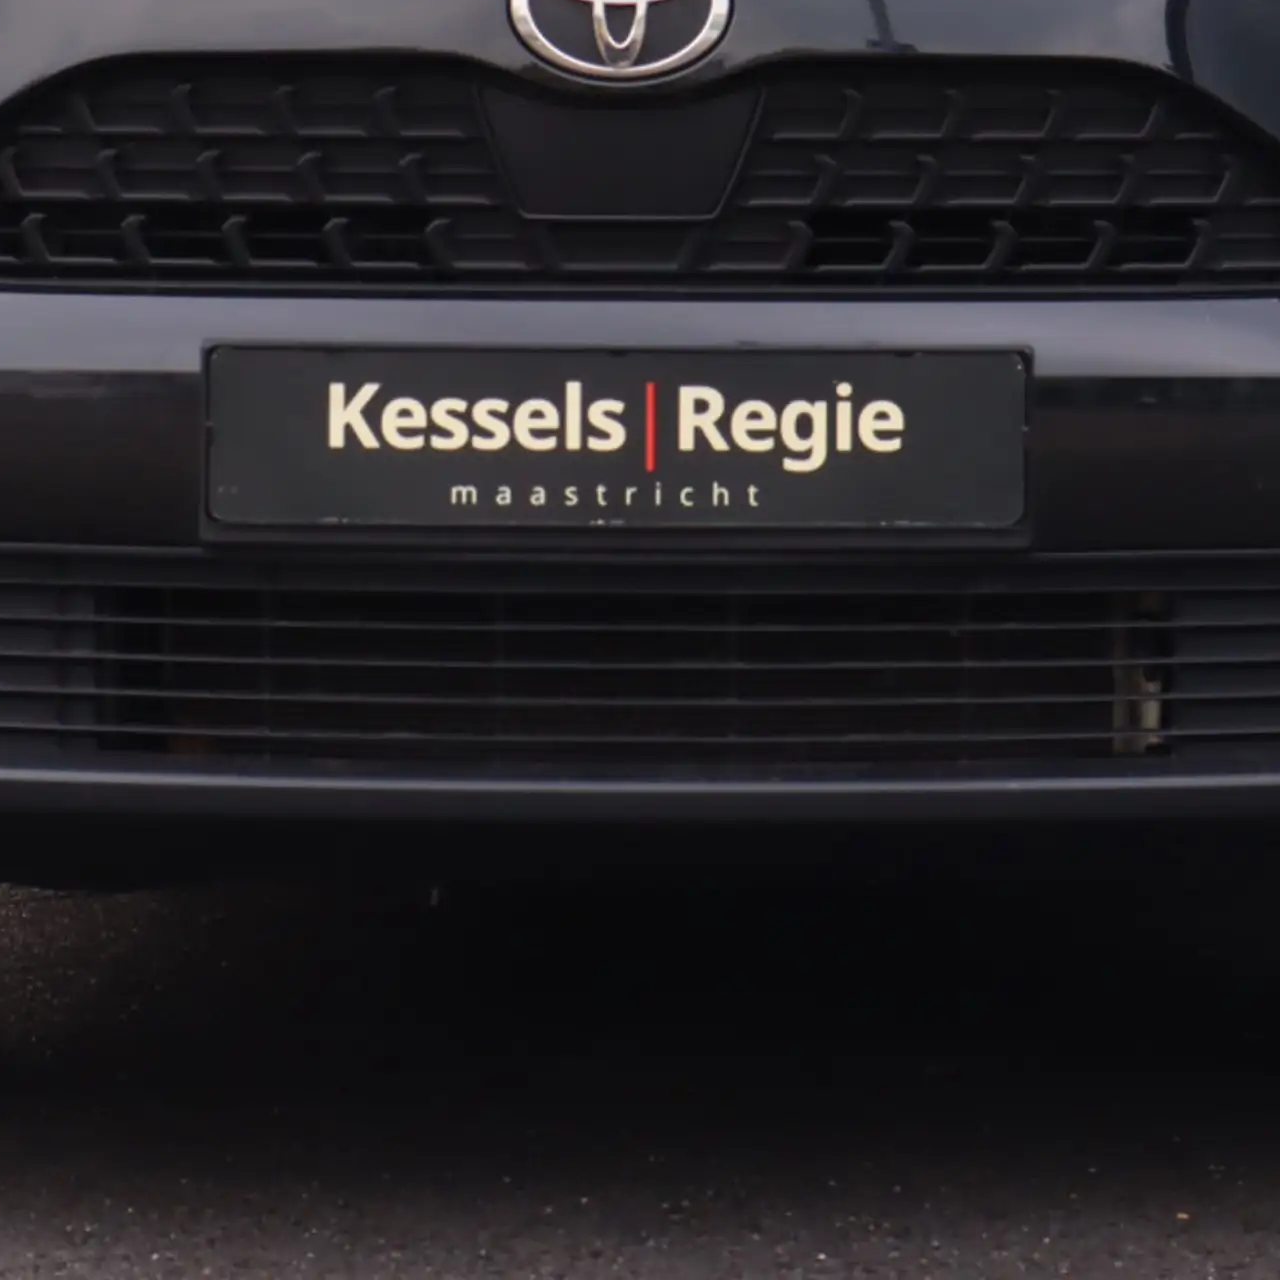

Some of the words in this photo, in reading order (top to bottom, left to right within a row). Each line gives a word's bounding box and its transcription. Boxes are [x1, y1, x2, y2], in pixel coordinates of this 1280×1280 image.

[327, 381, 627, 452] Kessels
[677, 382, 906, 472] Regie
[450, 481, 760, 507] maastricht
